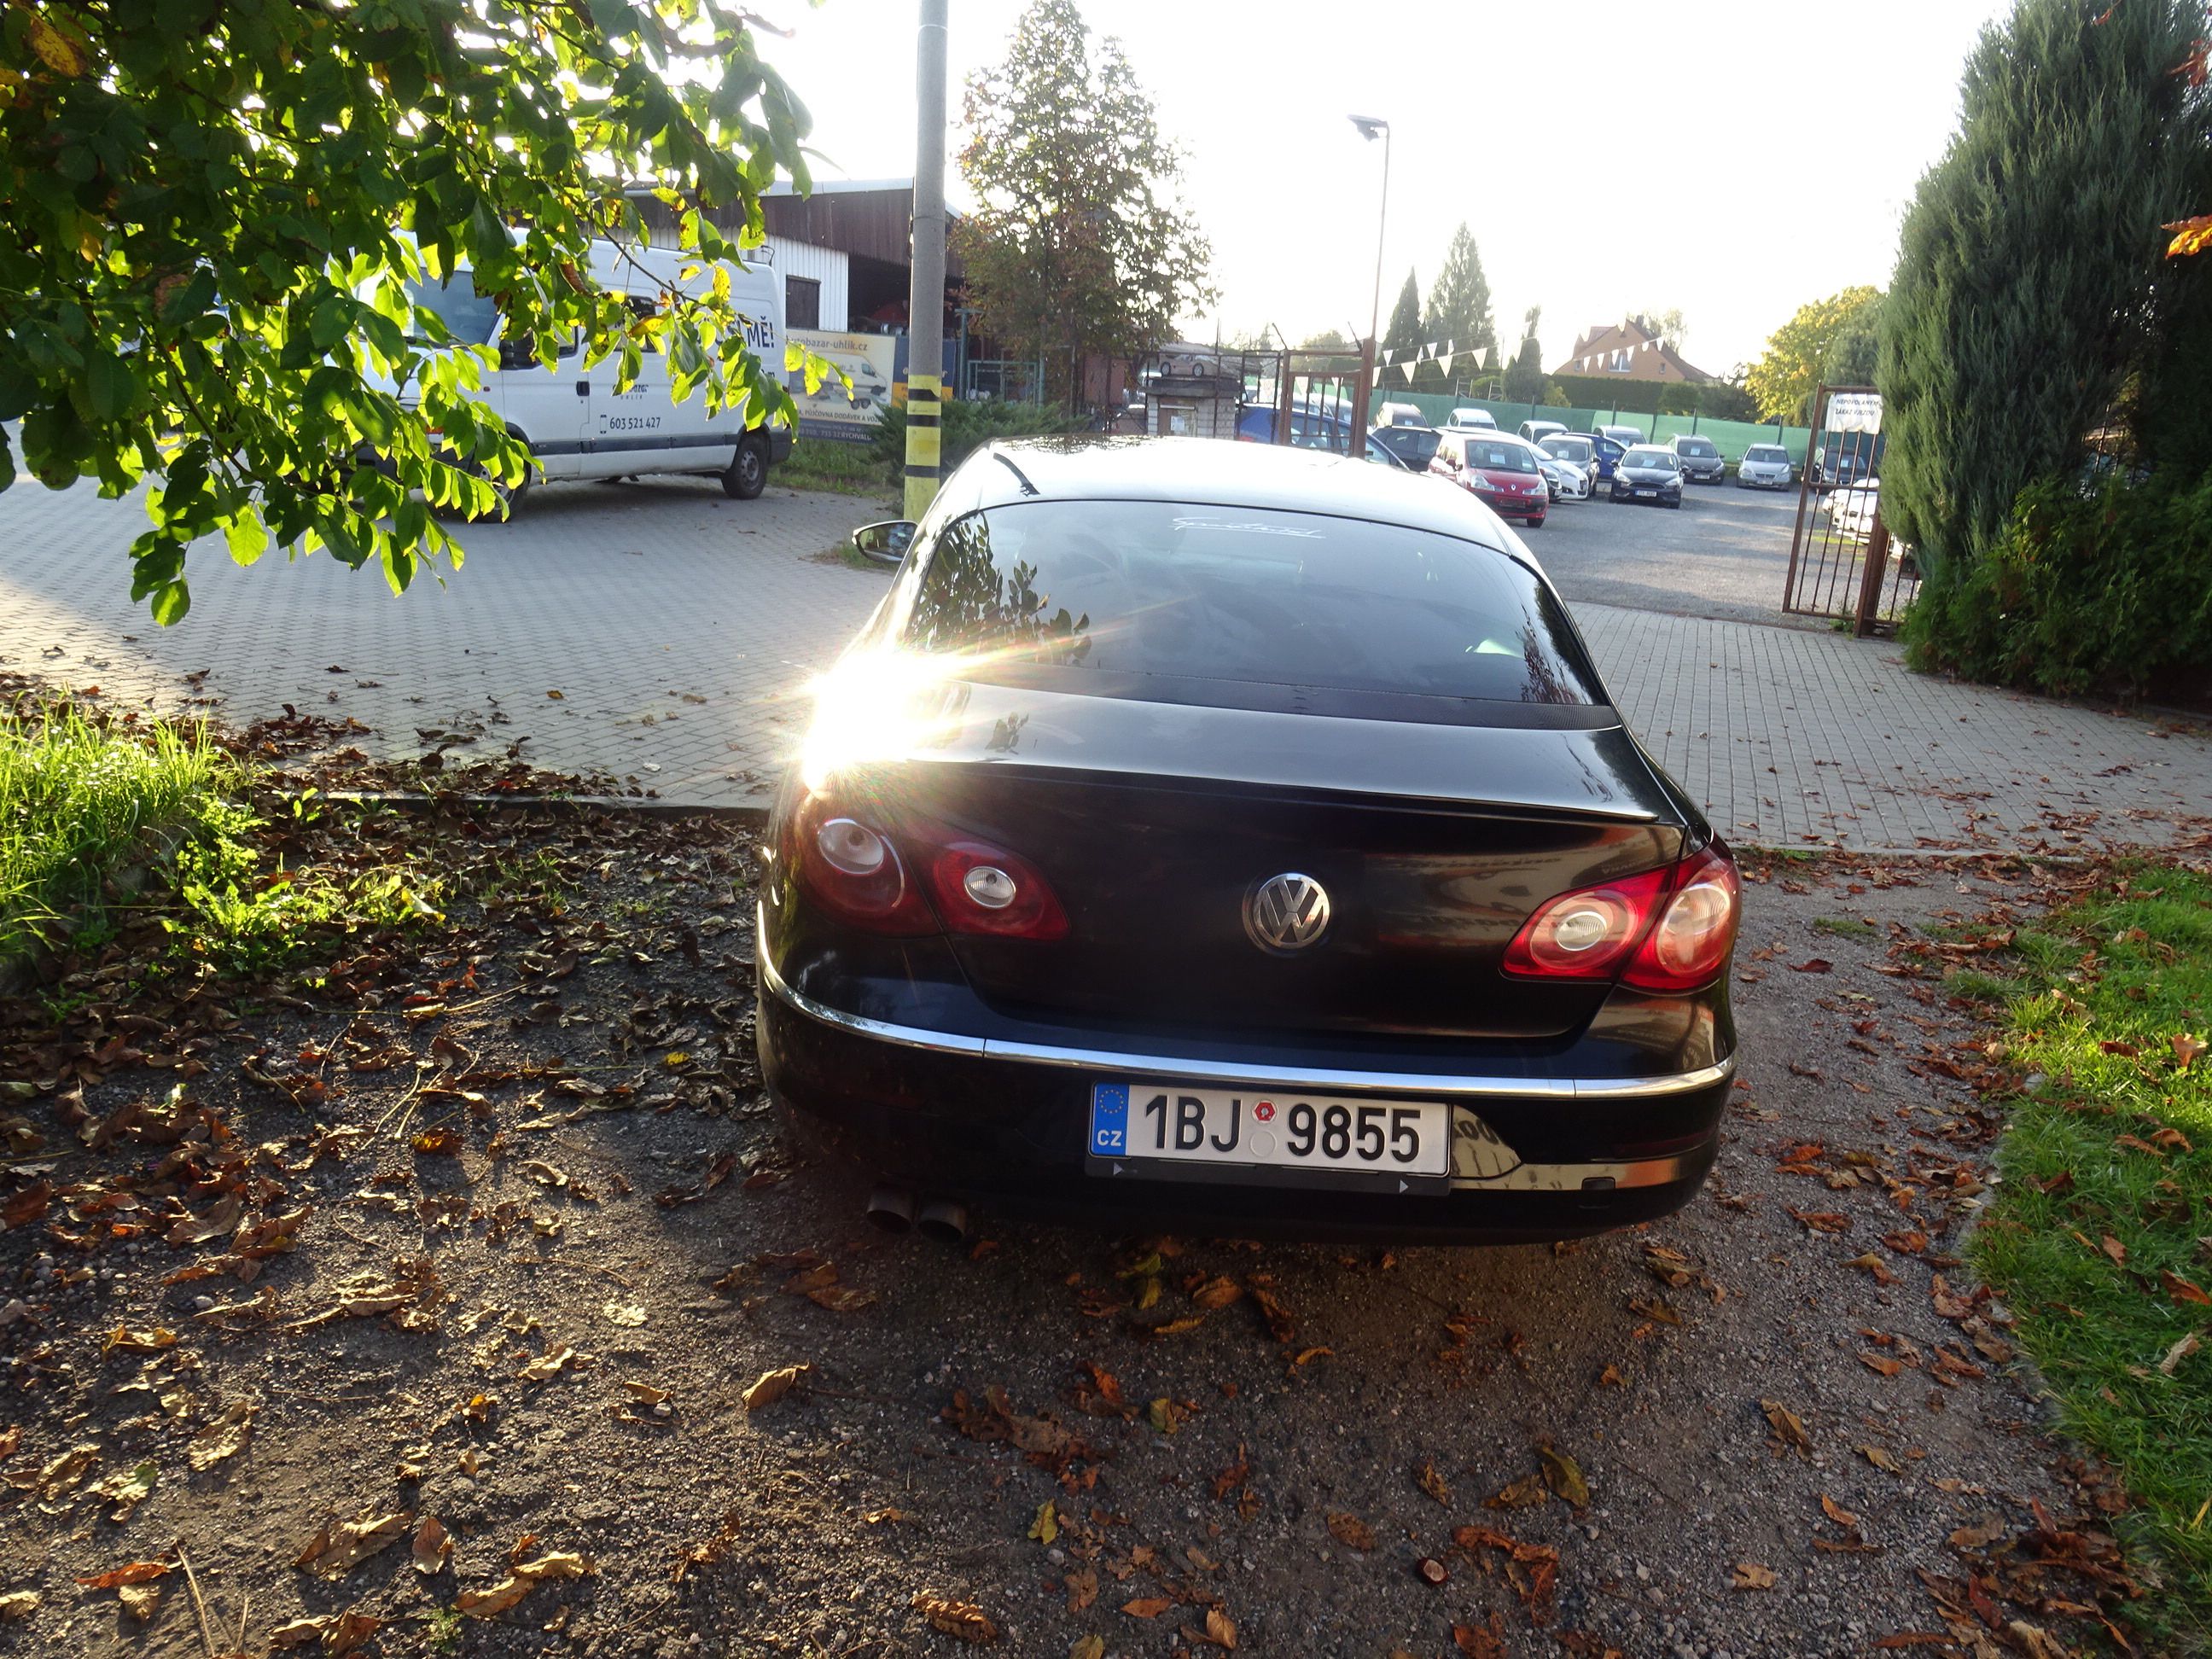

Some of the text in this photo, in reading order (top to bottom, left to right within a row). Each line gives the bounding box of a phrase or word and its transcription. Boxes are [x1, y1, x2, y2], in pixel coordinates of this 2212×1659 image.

[747, 316, 775, 348] MĚ!
[786, 335, 868, 351] utobazar-uhlik.cz
[609, 416, 661, 430] 603 521 427
[1097, 1128, 1122, 1147] CZ
[1145, 1095, 1243, 1153] 1BJ
[1287, 1103, 1422, 1163] 9855
